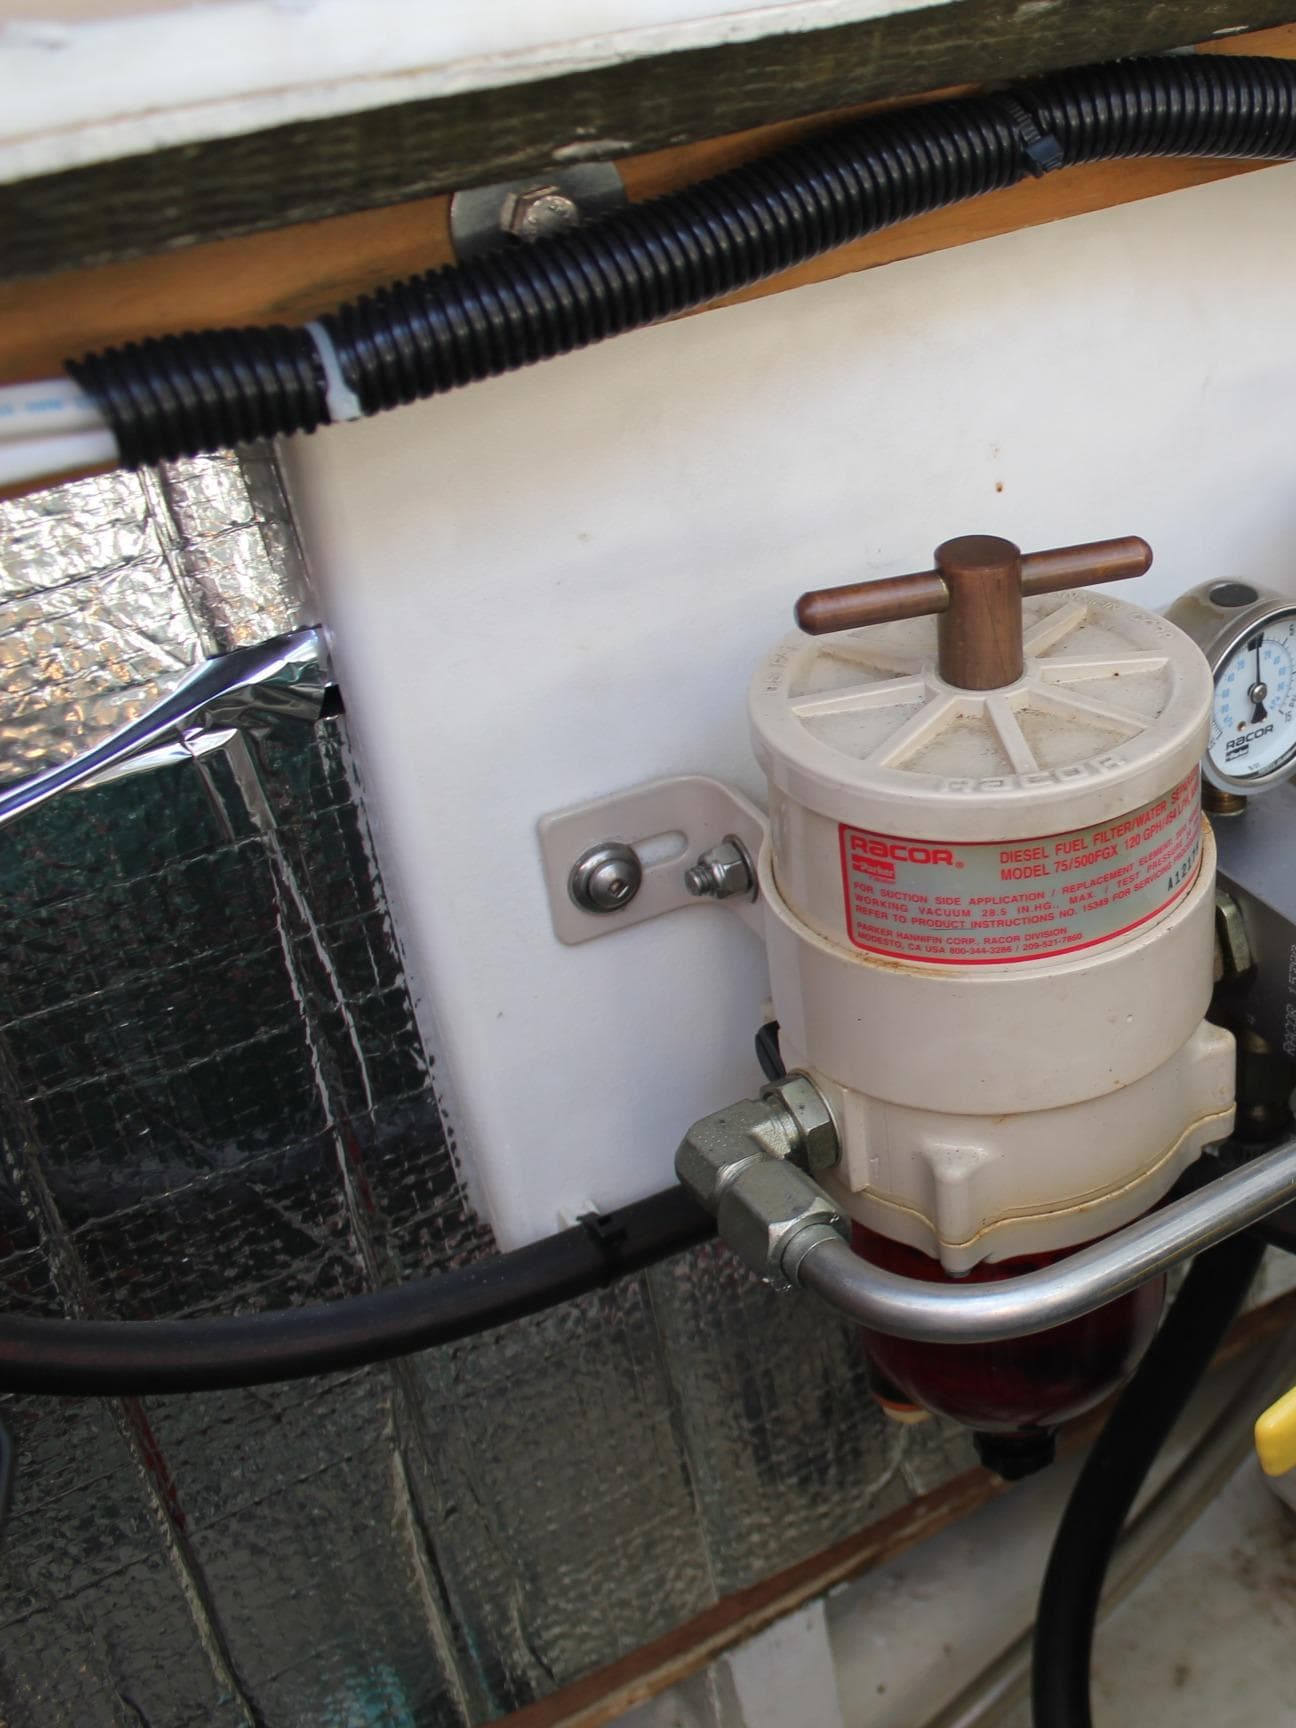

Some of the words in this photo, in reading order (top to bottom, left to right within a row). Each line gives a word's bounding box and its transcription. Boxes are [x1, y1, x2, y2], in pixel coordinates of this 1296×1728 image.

[1225, 723, 1275, 751] RACOR
[1000, 846, 1049, 864] DIESEL
[1055, 838, 1088, 856] FUEL
[1093, 800, 1168, 846] FILTER/WATER
[850, 833, 954, 866] RACOR
[1000, 863, 1051, 880] MODEL
[1054, 844, 1119, 873] 75/500FGX
[1125, 833, 1141, 850] 120
[854, 881, 875, 894] FOR
[880, 888, 928, 904] SUCTION
[935, 896, 962, 906] SIDE
[968, 891, 1045, 906] APPLICATION
[1062, 863, 1135, 894] REPLACEMENT
[854, 893, 909, 913] WORKING
[918, 906, 972, 917] VACUUM
[856, 904, 888, 919] REFER
[892, 913, 907, 923] TO
[911, 916, 966, 929] PRODUCT
[971, 912, 1055, 929] INSTRUCTIONS
[1113, 888, 1132, 901] FOR
[857, 921, 893, 936] PARKER
[896, 930, 942, 945] HANNIFIN
[983, 935, 1021, 945] RACOR
[1025, 927, 1068, 941] DIVISION
[908, 943, 921, 951] CA
[925, 945, 945, 954] USA
